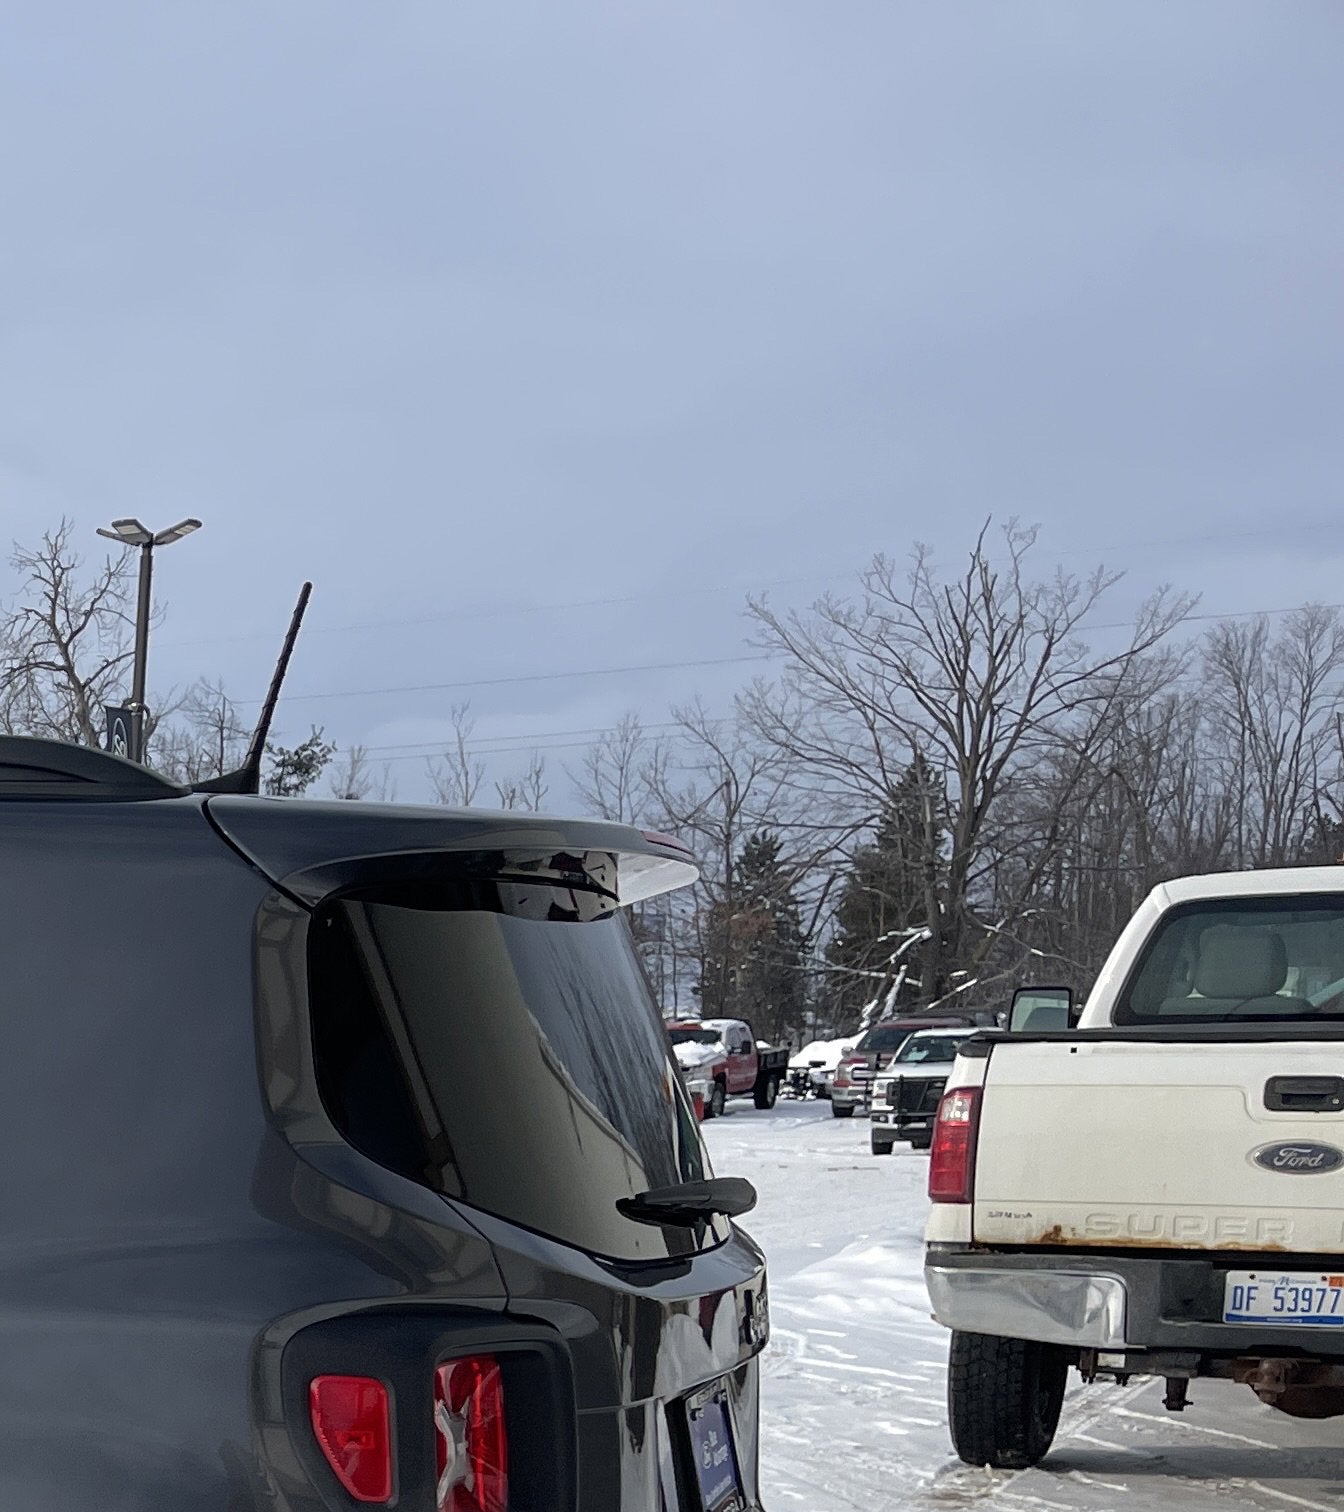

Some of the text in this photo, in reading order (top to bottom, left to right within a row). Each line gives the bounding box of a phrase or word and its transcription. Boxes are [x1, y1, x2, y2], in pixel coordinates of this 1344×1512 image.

[1273, 1147, 1325, 1167] Ford
[1084, 1212, 1295, 1244] SUPER
[1232, 1285, 1342, 1313] DF 53977
